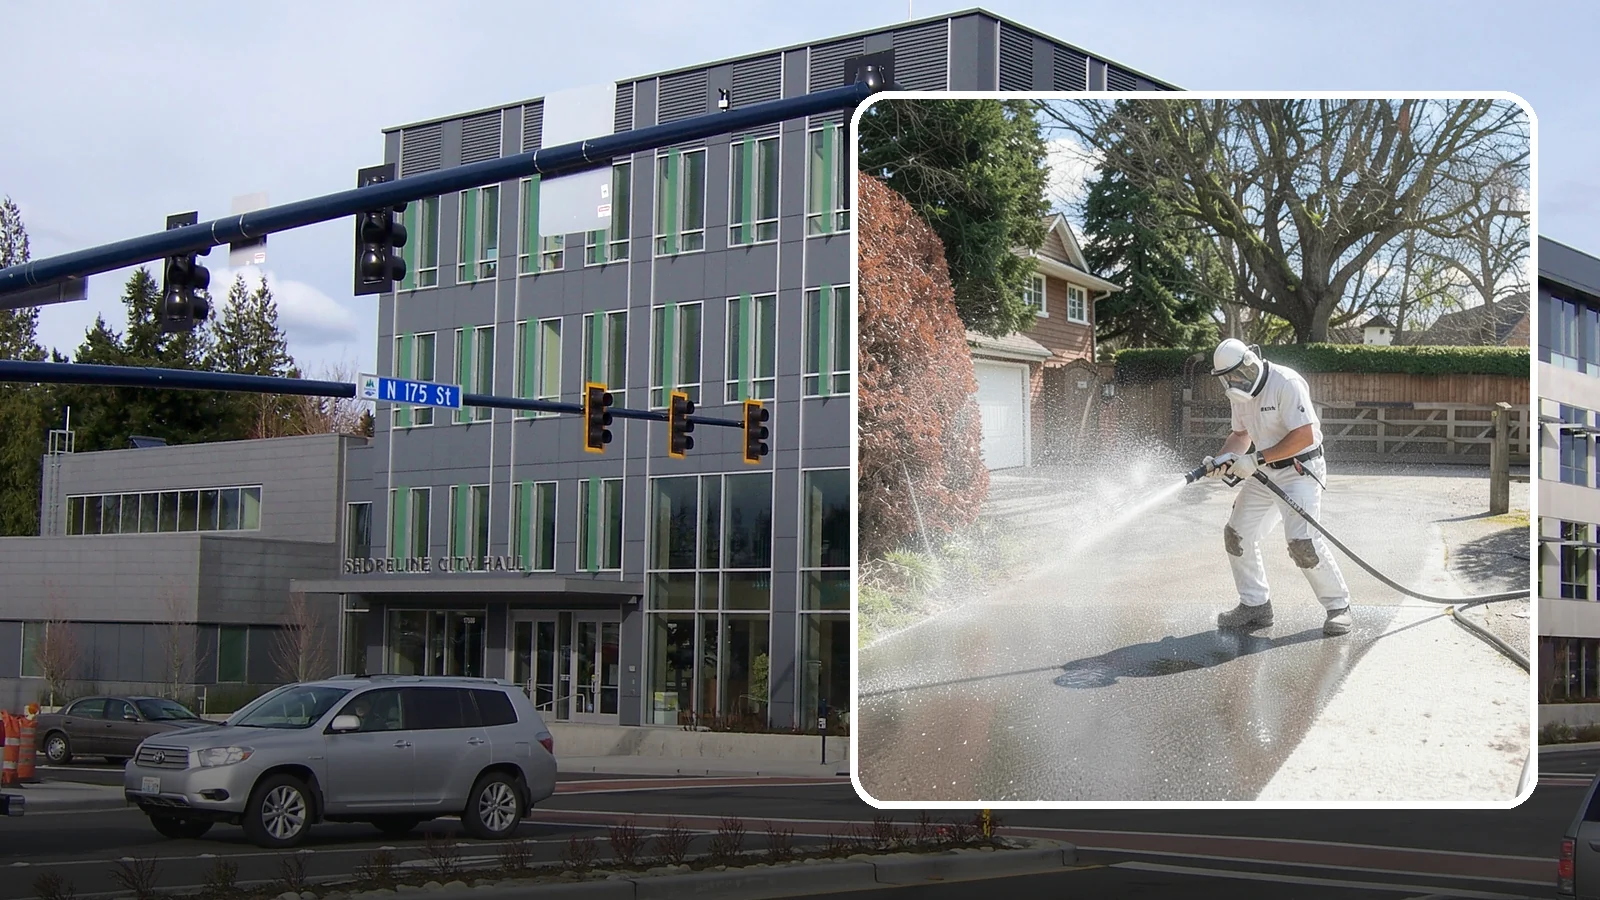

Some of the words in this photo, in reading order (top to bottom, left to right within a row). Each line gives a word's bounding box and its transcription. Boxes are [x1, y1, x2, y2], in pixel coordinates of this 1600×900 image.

[387, 380, 396, 400] N
[405, 382, 428, 403] 175
[436, 386, 451, 406] St
[344, 557, 432, 574] SHORELINE
[438, 556, 475, 572] CITY
[484, 555, 525, 571] HALL
